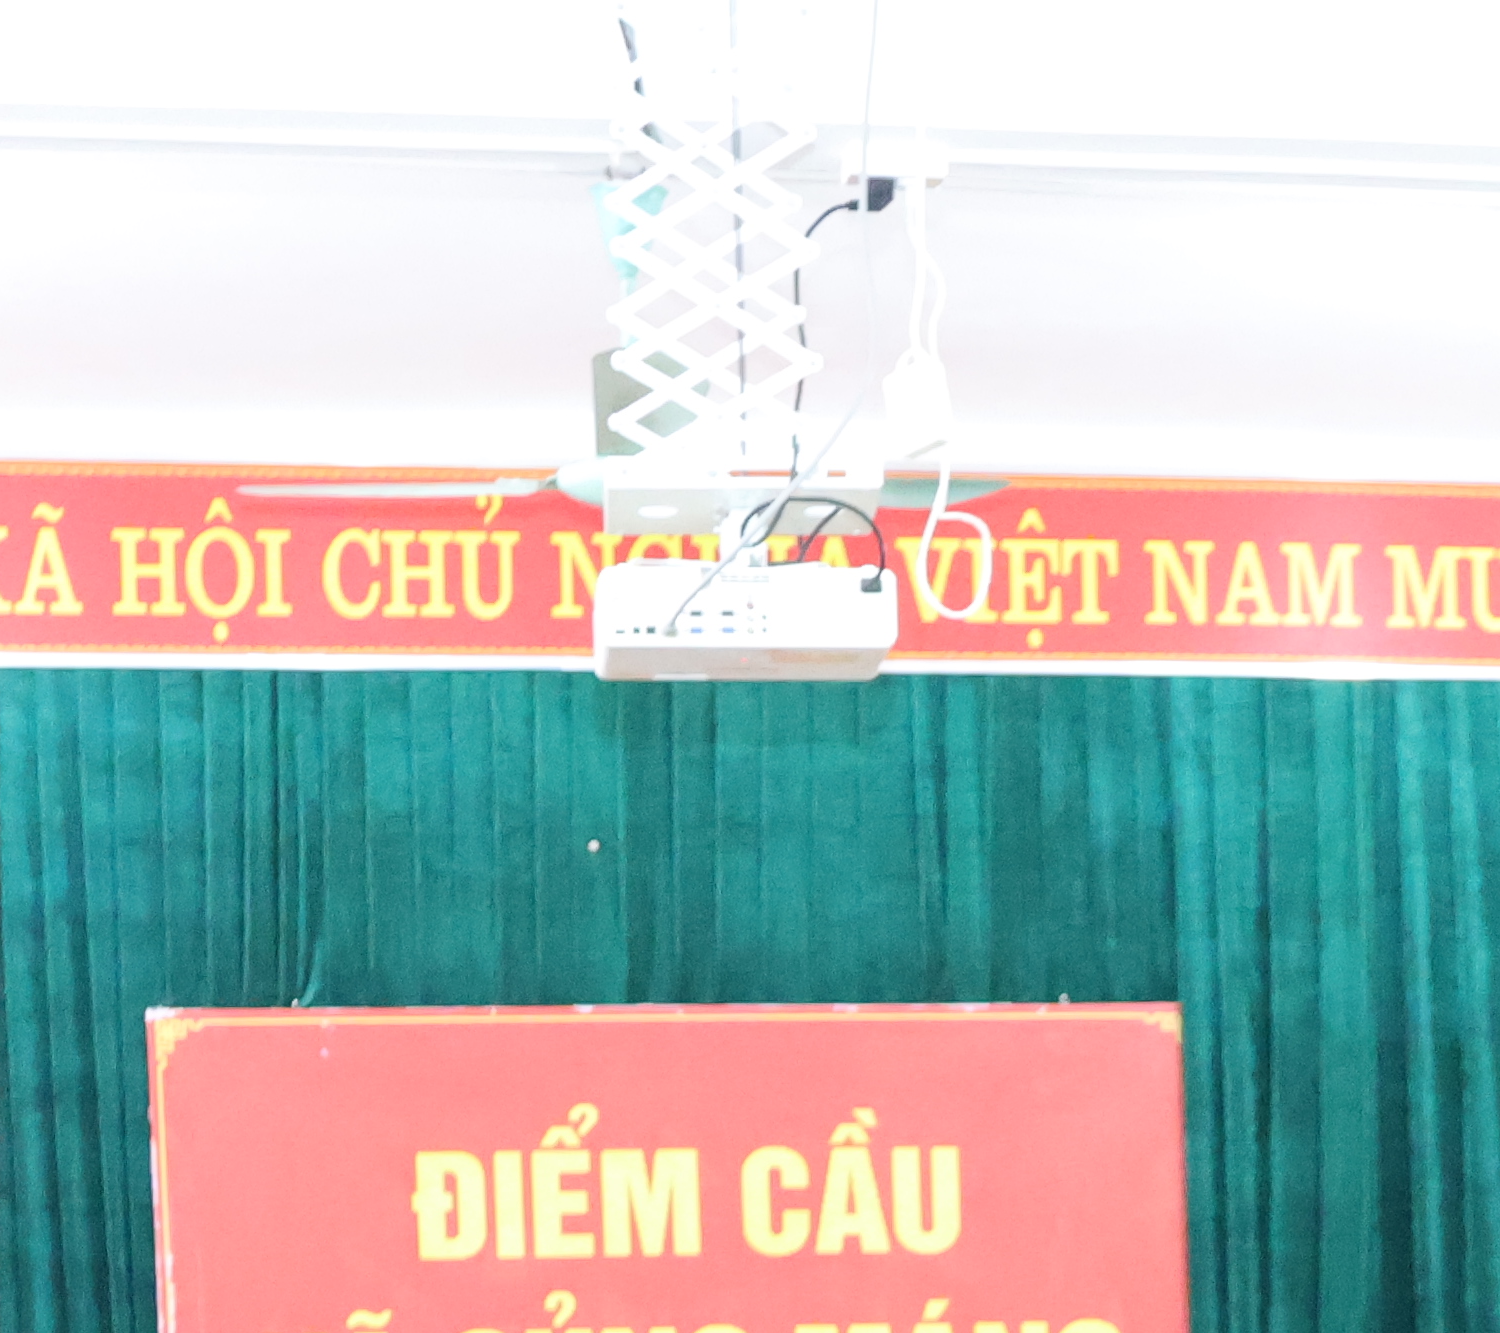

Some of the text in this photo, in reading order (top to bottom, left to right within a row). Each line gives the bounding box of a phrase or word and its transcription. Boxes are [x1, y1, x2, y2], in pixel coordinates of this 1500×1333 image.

[112, 497, 294, 643] HỘI
[321, 495, 521, 620] CHỦ
[894, 509, 1119, 646] VIỆT
[1144, 539, 1362, 630] NAM
[411, 1103, 961, 1262] ĐIỂM CẦU
